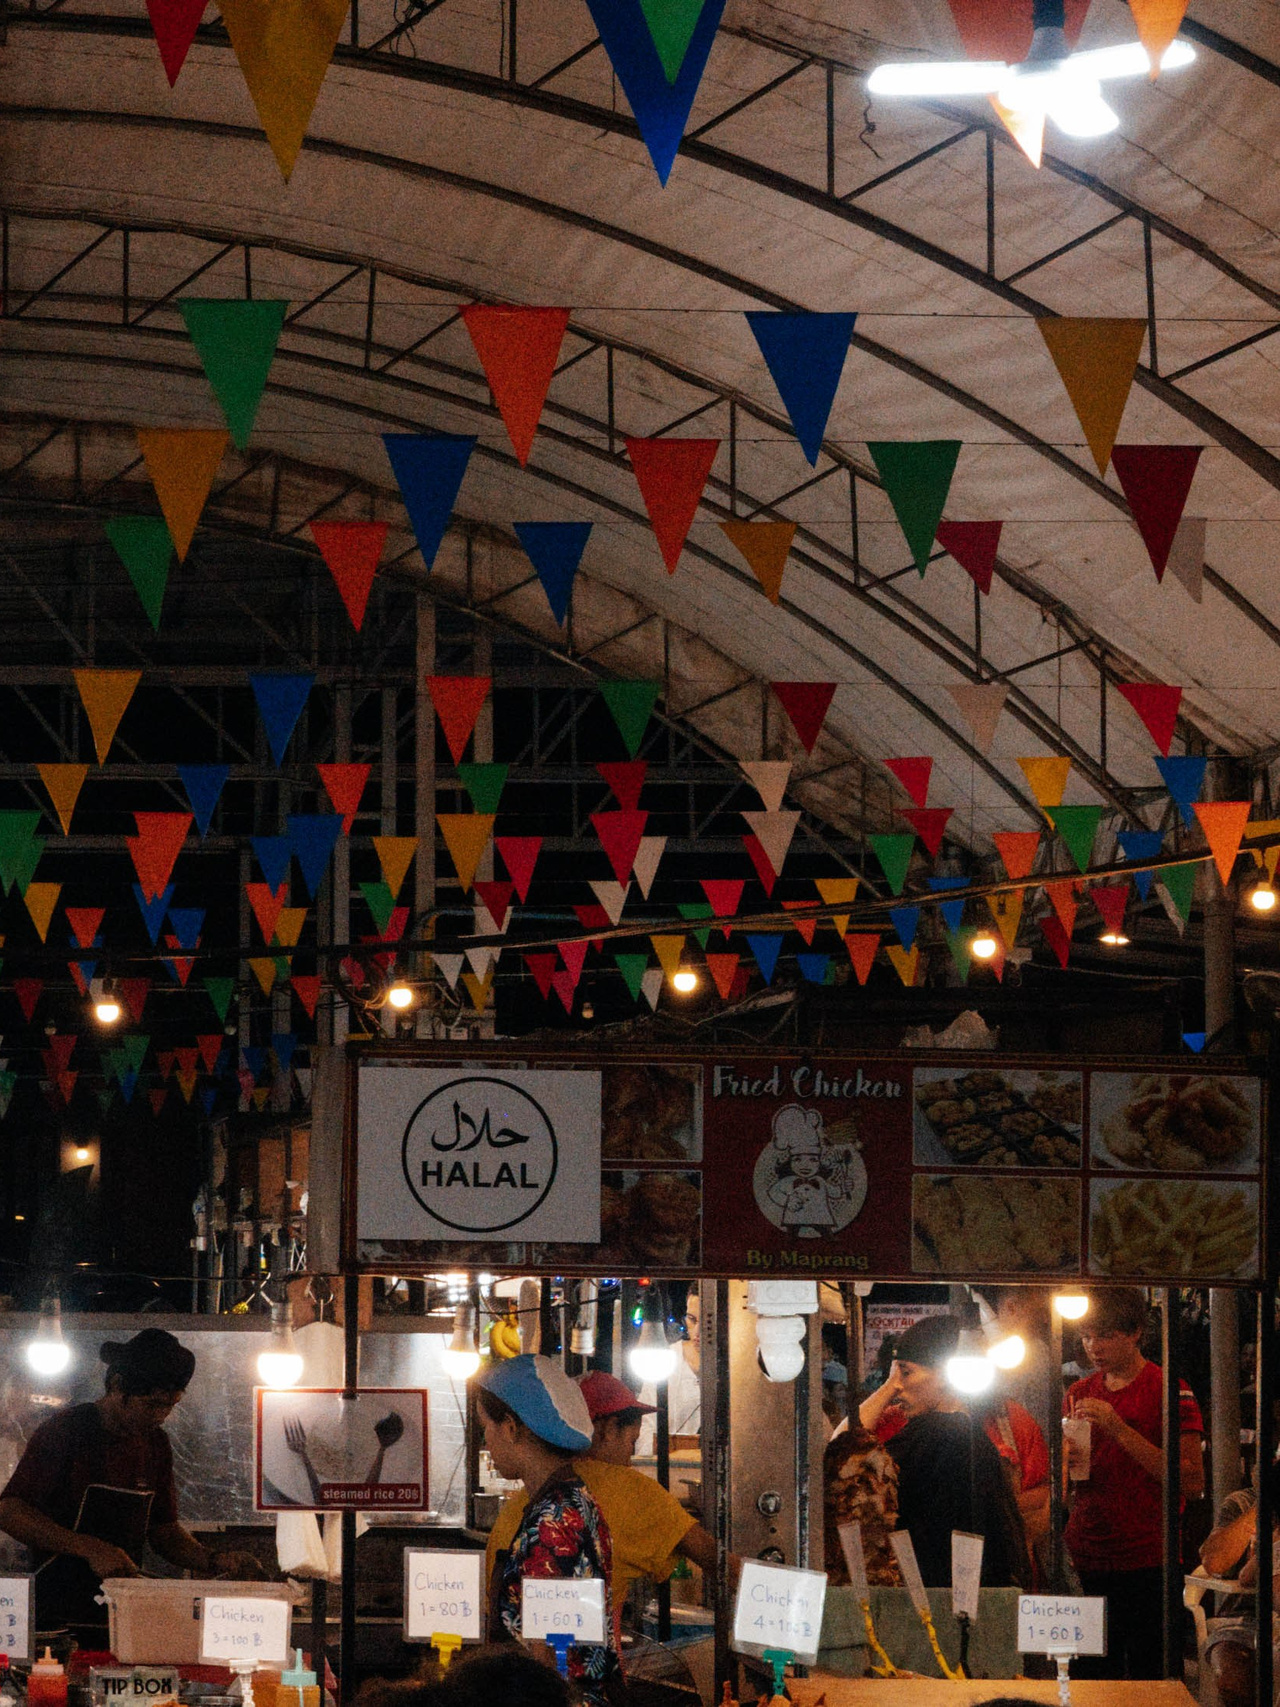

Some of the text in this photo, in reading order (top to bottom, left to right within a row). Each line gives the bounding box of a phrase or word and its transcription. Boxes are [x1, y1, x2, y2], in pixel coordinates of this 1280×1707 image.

[713, 1066, 903, 1098] Fried Chicken
[431, 1100, 530, 1152] حلال
[422, 1161, 539, 1188] HALAL
[747, 1249, 869, 1270] By Maprang
[323, 1488, 370, 1500] steamed
[373, 1488, 395, 1500] rice
[415, 1572, 465, 1592] Chicken
[524, 1584, 580, 1600] Chicken
[210, 1604, 264, 1624] Chicken
[1021, 1598, 1081, 1617] Chicken
[102, 1678, 172, 1695] TIP BOX
